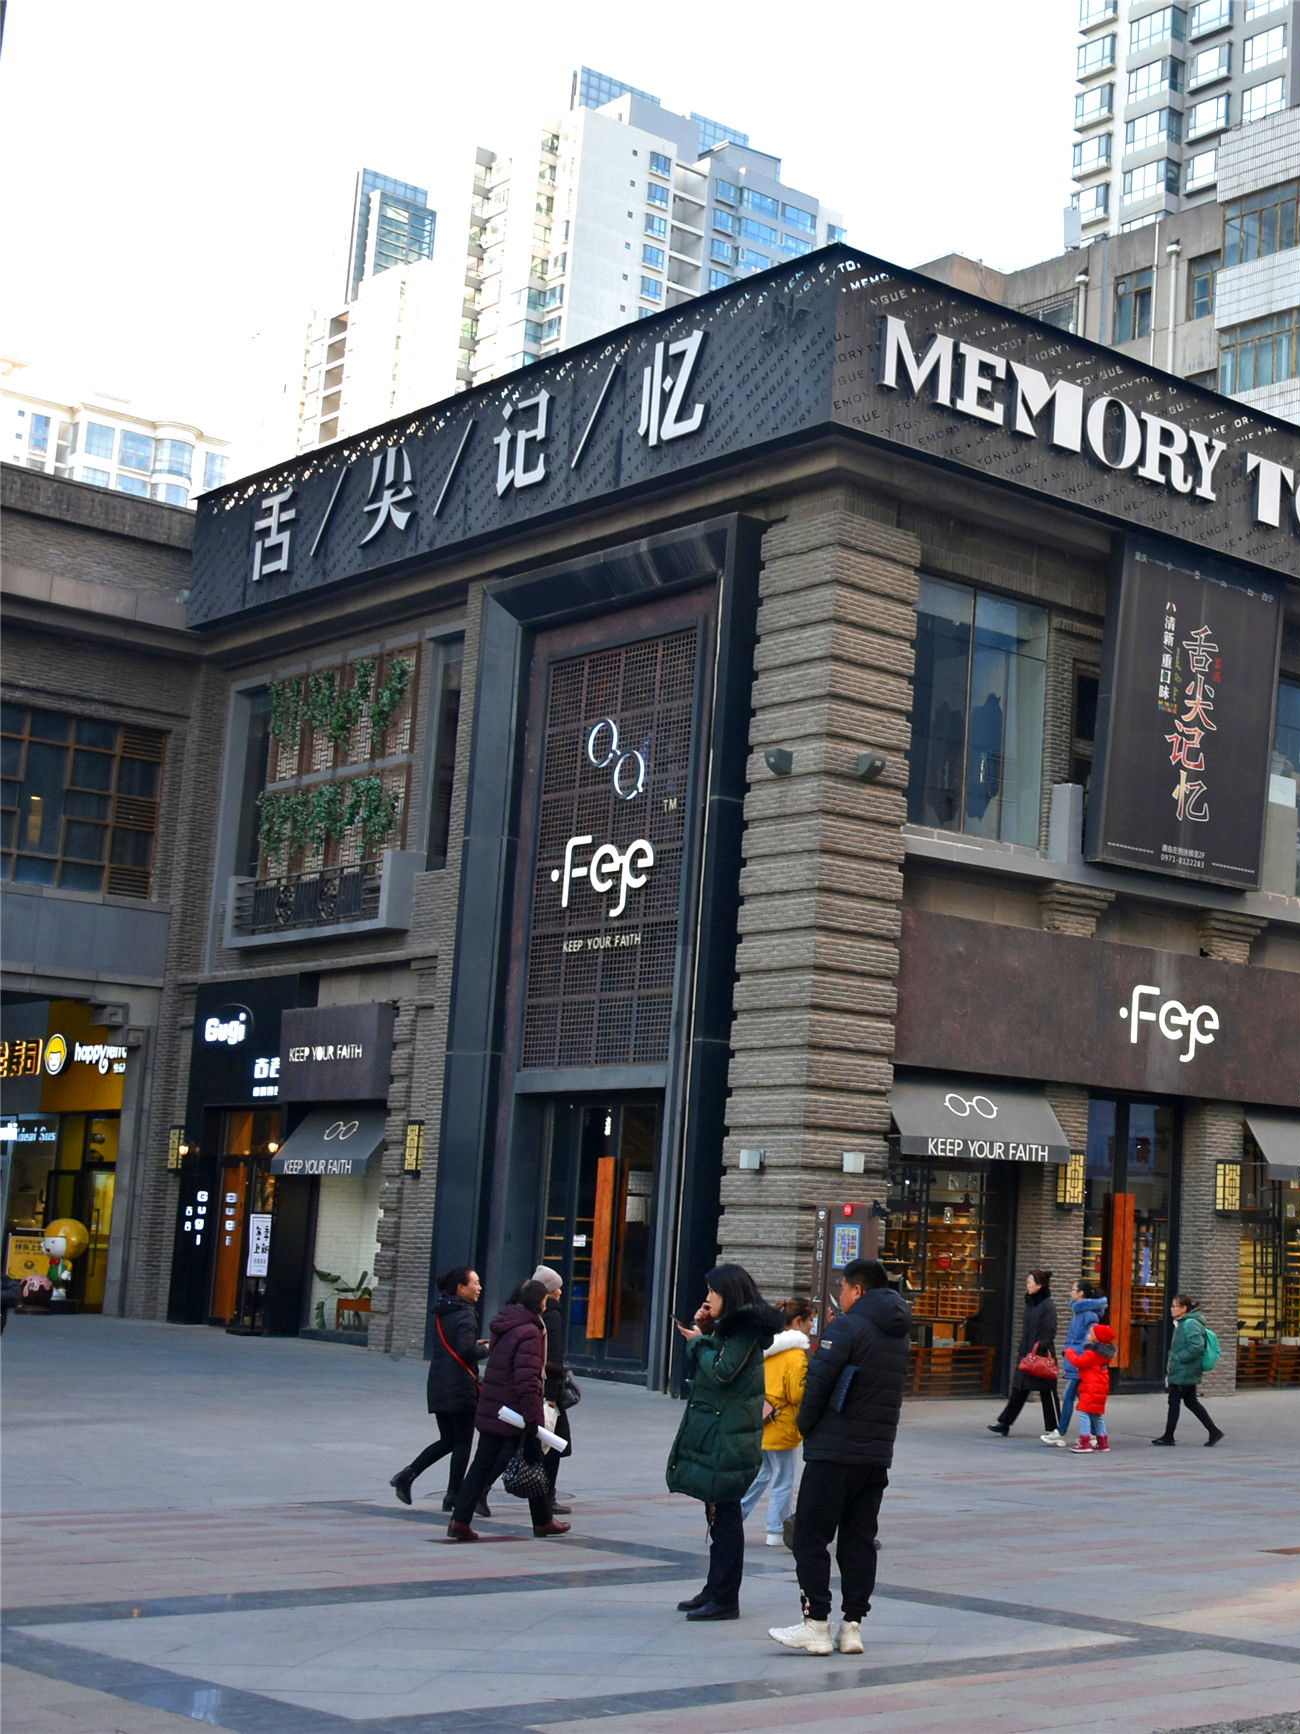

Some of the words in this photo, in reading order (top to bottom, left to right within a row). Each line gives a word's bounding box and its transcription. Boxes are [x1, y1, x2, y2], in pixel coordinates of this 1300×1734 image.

[875, 313, 1227, 502] MEMORY
[1164, 624, 1219, 822] 舌尖记忆
[562, 940, 584, 952] KEEP
[587, 936, 611, 950] YOUR
[614, 932, 641, 948] FAITH
[205, 1013, 247, 1045] Gugi
[289, 1047, 309, 1062] KEEP
[312, 1045, 335, 1060] YOUR
[337, 1044, 363, 1060] FAITH
[928, 1136, 965, 1156] KEEP
[968, 1139, 1006, 1159] YOUR
[1009, 1143, 1049, 1163] FAITH
[283, 1161, 302, 1174] KEEP
[305, 1160, 325, 1174] YOUR
[327, 1159, 353, 1174] FAITH
[195, 1190, 209, 1246] Gugi
